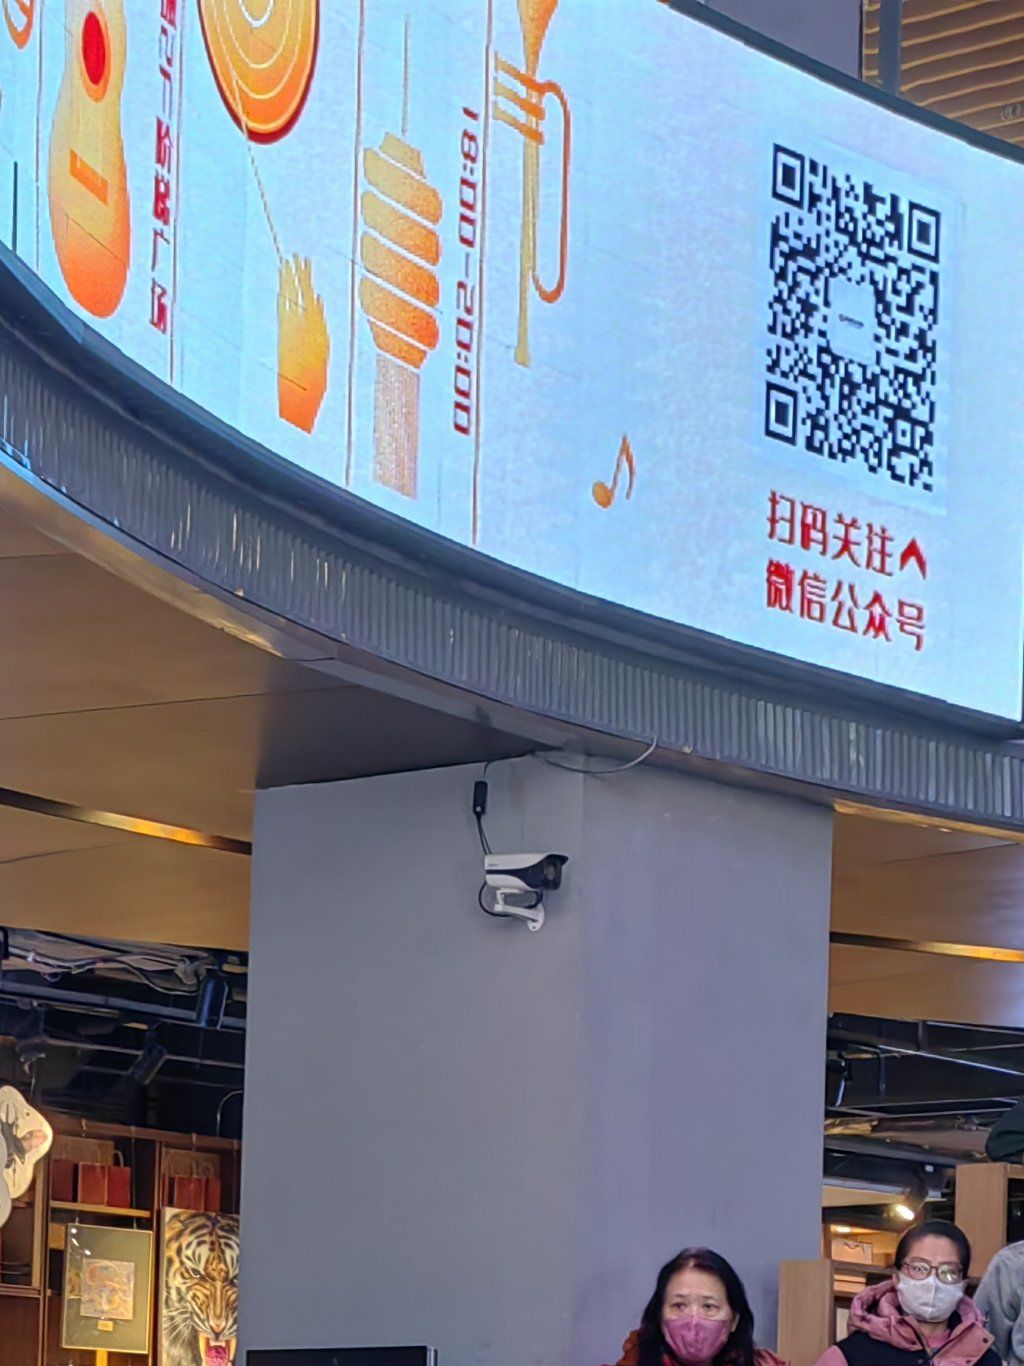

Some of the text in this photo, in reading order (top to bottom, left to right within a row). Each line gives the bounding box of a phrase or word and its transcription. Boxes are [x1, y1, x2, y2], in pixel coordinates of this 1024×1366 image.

[453, 106, 480, 437] 18:00-20:00
[767, 489, 895, 578] 扫码关注
[765, 559, 926, 651] 微信公众号
